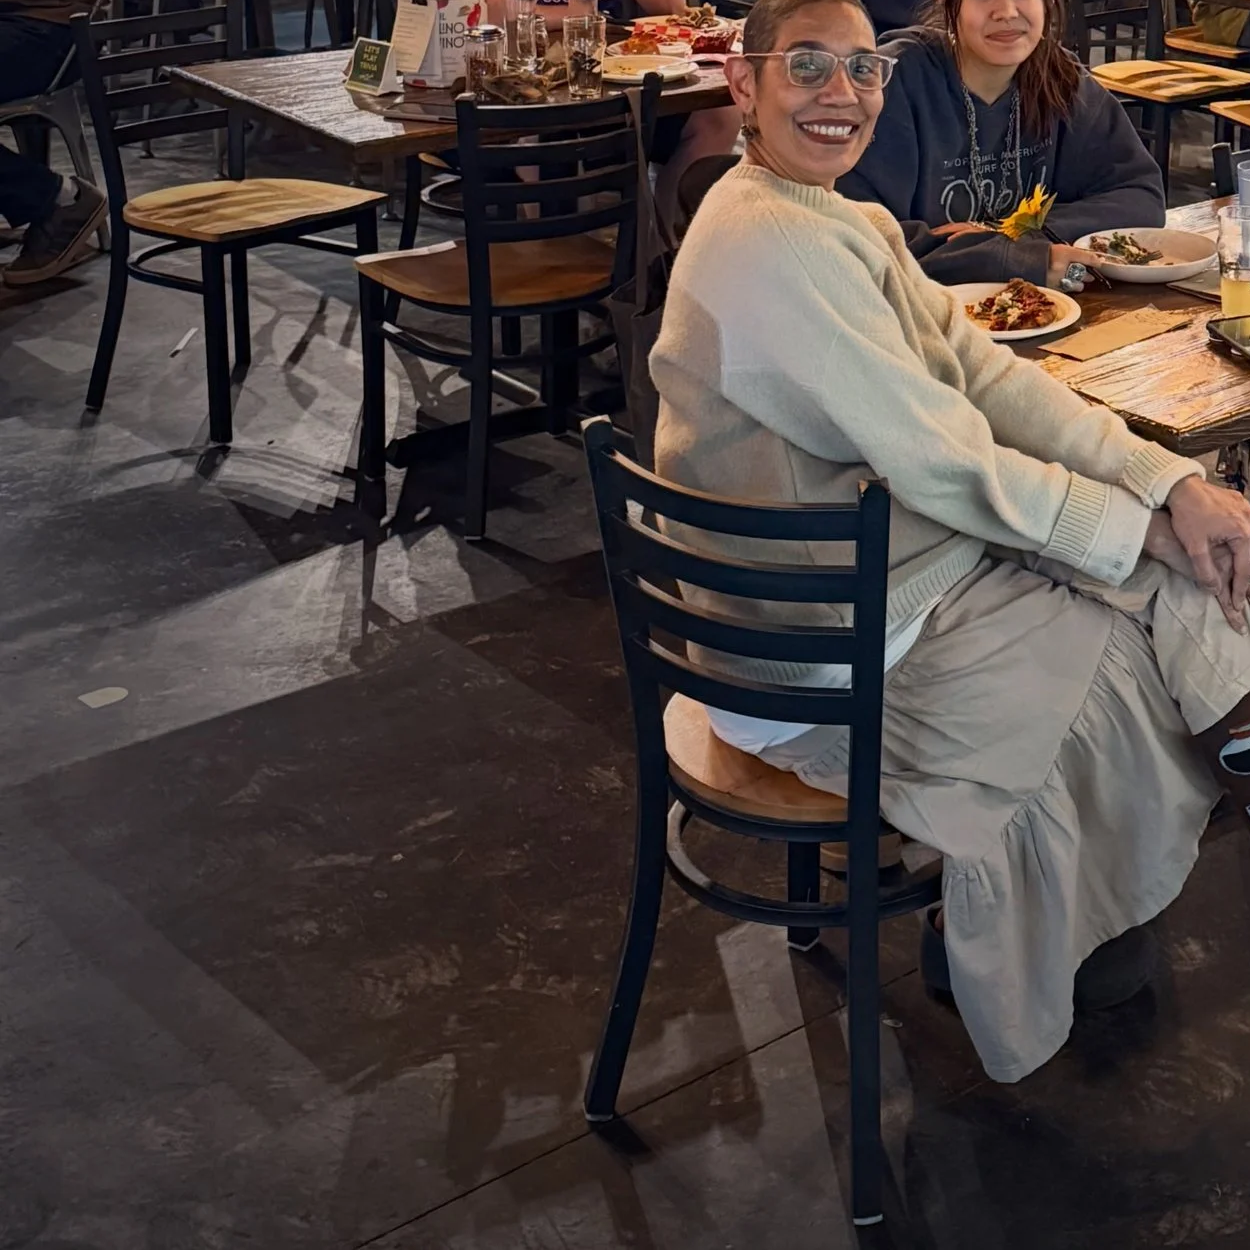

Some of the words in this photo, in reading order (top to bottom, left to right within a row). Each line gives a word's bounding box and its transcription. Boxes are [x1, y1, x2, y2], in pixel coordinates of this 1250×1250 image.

[439, 21, 465, 35] LINO
[364, 45, 380, 55] LET'S
[363, 53, 378, 62] PLAY
[360, 61, 378, 71] TRIVIA
